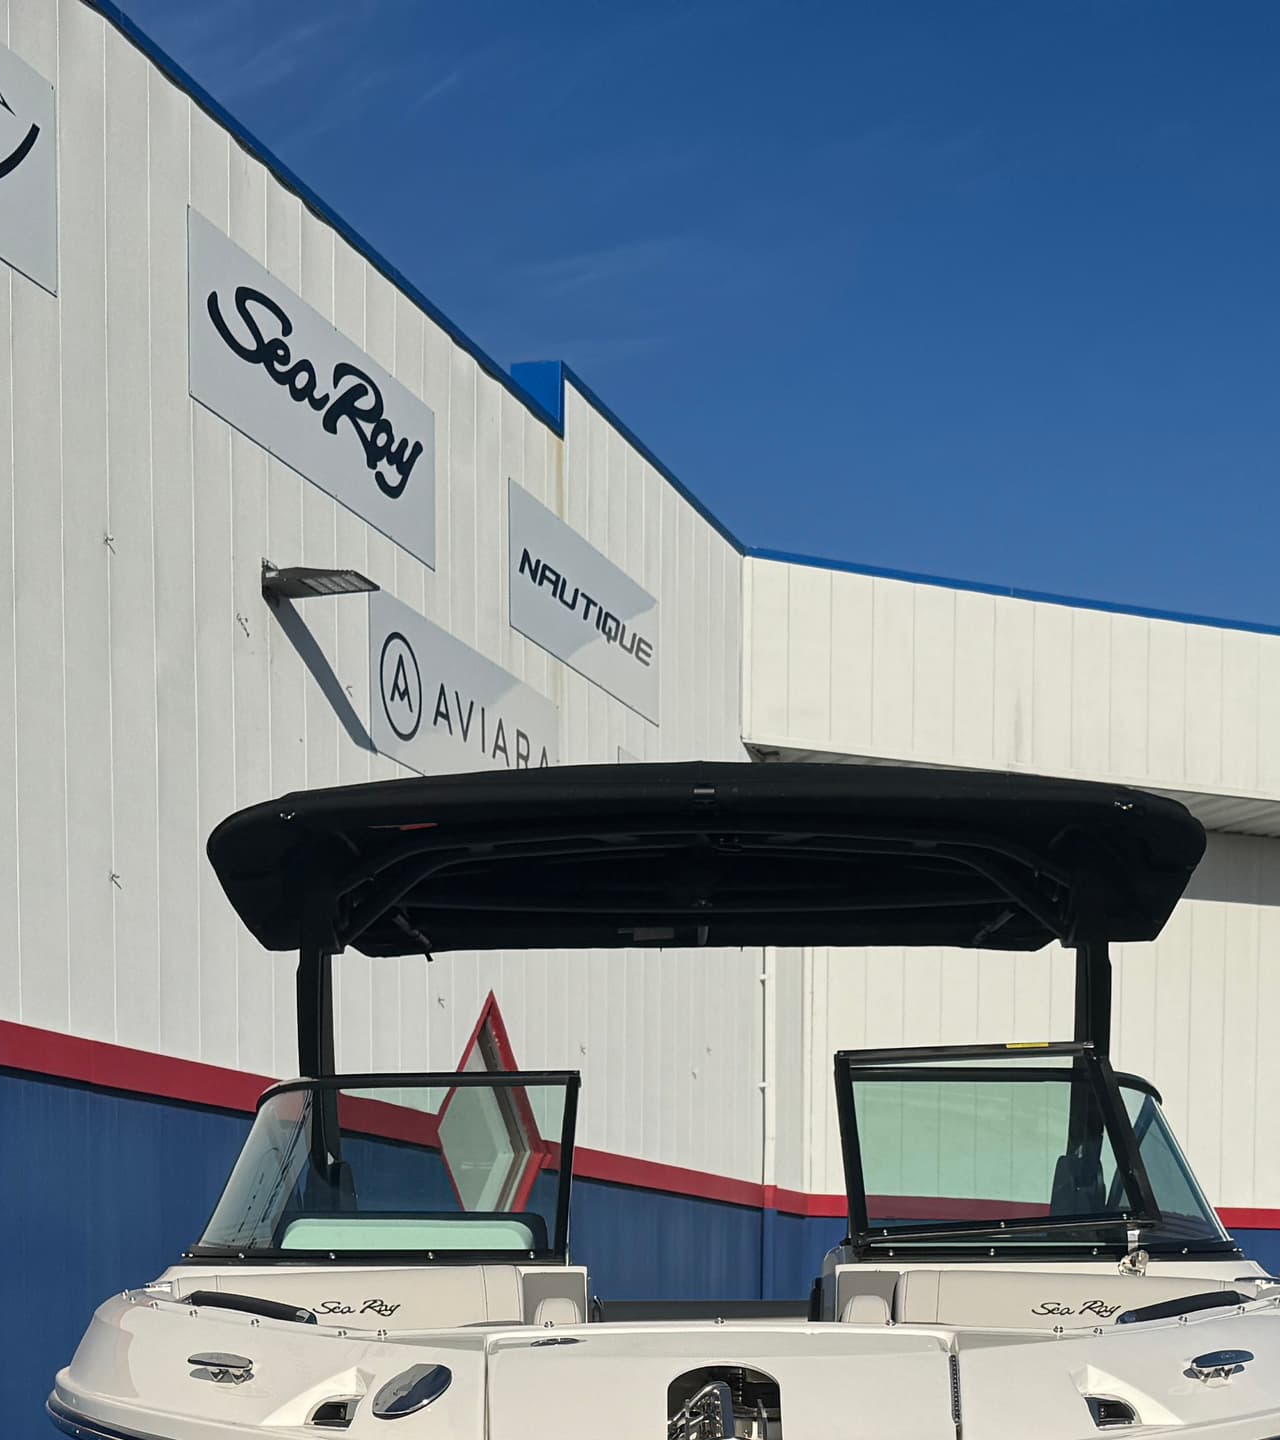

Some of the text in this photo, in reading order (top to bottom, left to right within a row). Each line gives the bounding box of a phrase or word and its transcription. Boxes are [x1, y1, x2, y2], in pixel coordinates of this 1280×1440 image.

[519, 547, 654, 668] NAUTIQUE
[312, 1299, 401, 1317] Sea Ray
[1031, 1300, 1122, 1318] Sea Ray
